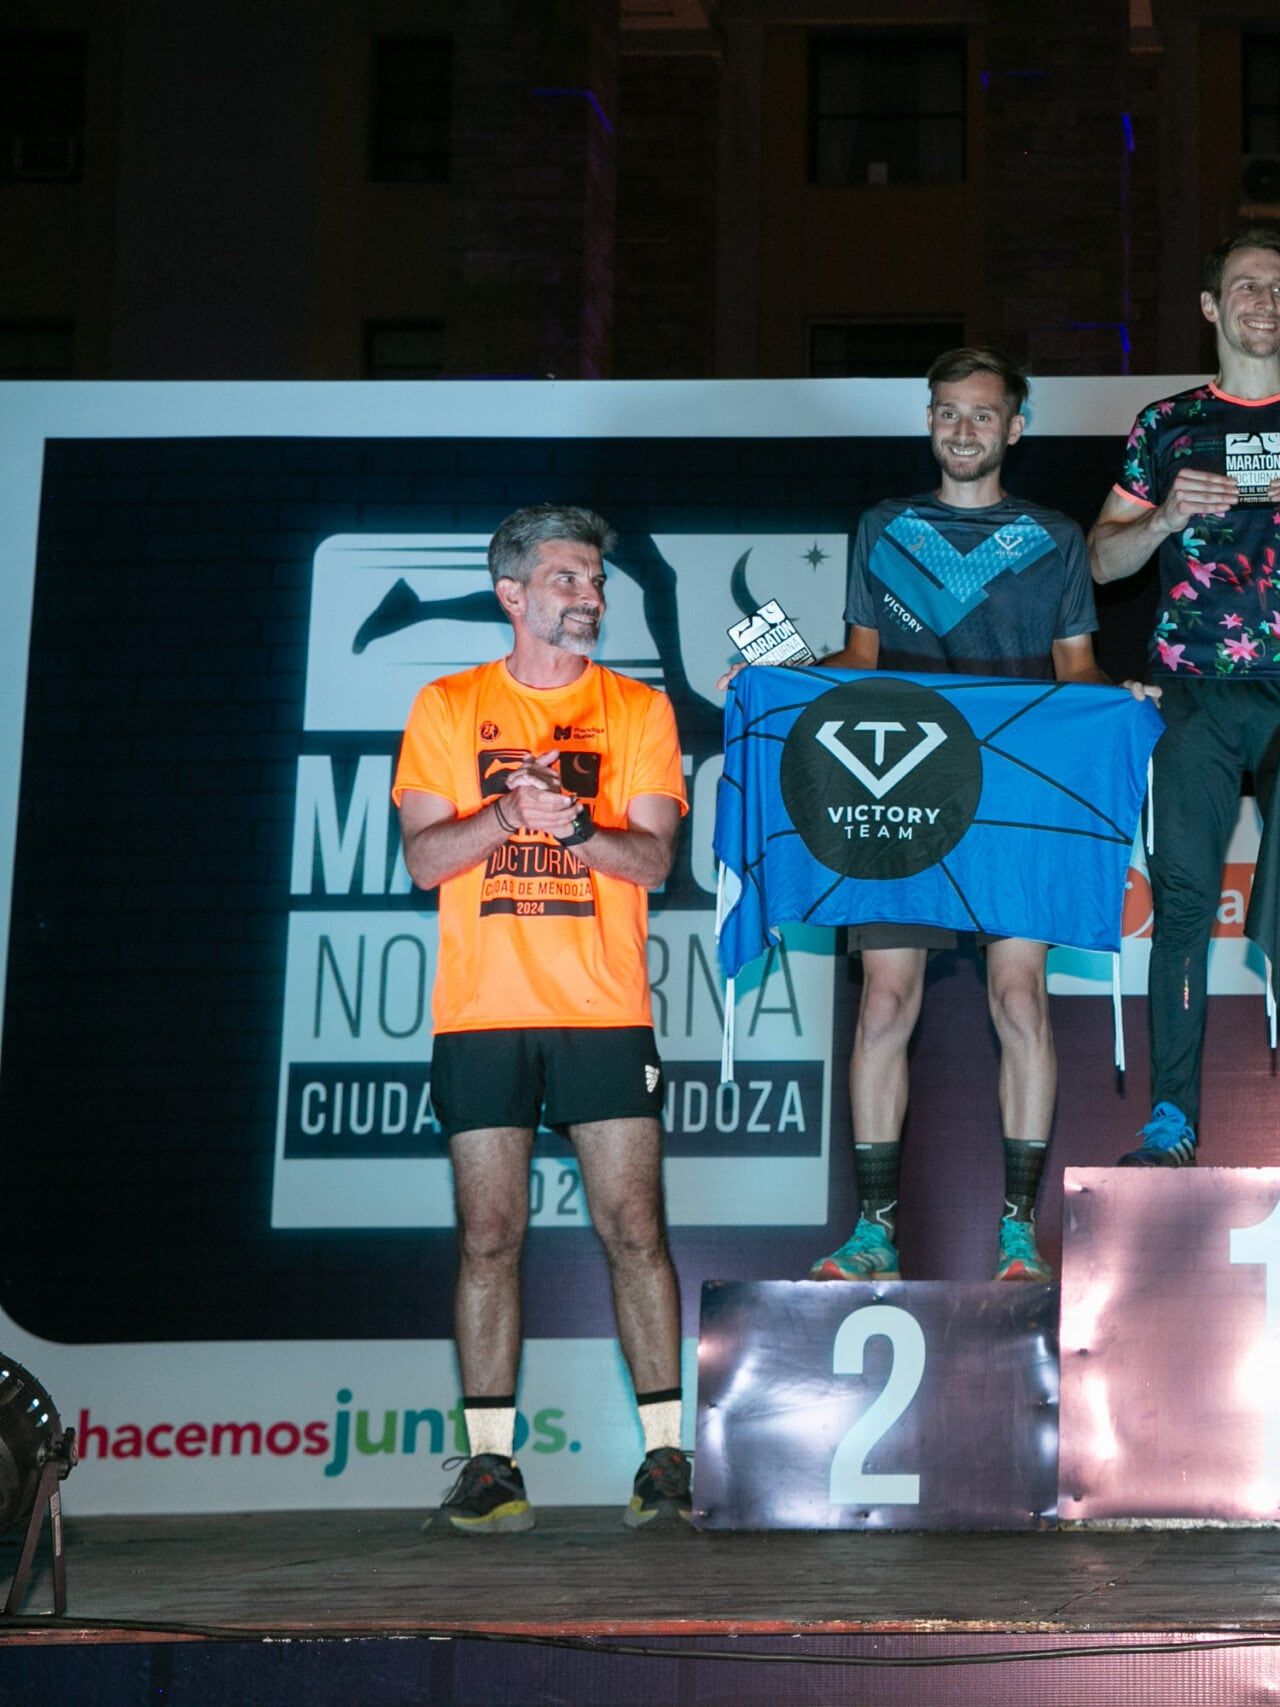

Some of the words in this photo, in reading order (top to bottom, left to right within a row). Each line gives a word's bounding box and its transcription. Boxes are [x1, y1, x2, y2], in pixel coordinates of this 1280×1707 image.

[883, 593, 923, 633] VICTORY
[827, 804, 940, 824] VICTORY
[844, 825, 913, 840] TEAM
[518, 883, 533, 895] DE
[538, 882, 592, 897] MENDOZA
[516, 902, 545, 915] 2024
[300, 1081, 442, 1136] CIUDA
[829, 1305, 926, 1504] 2
